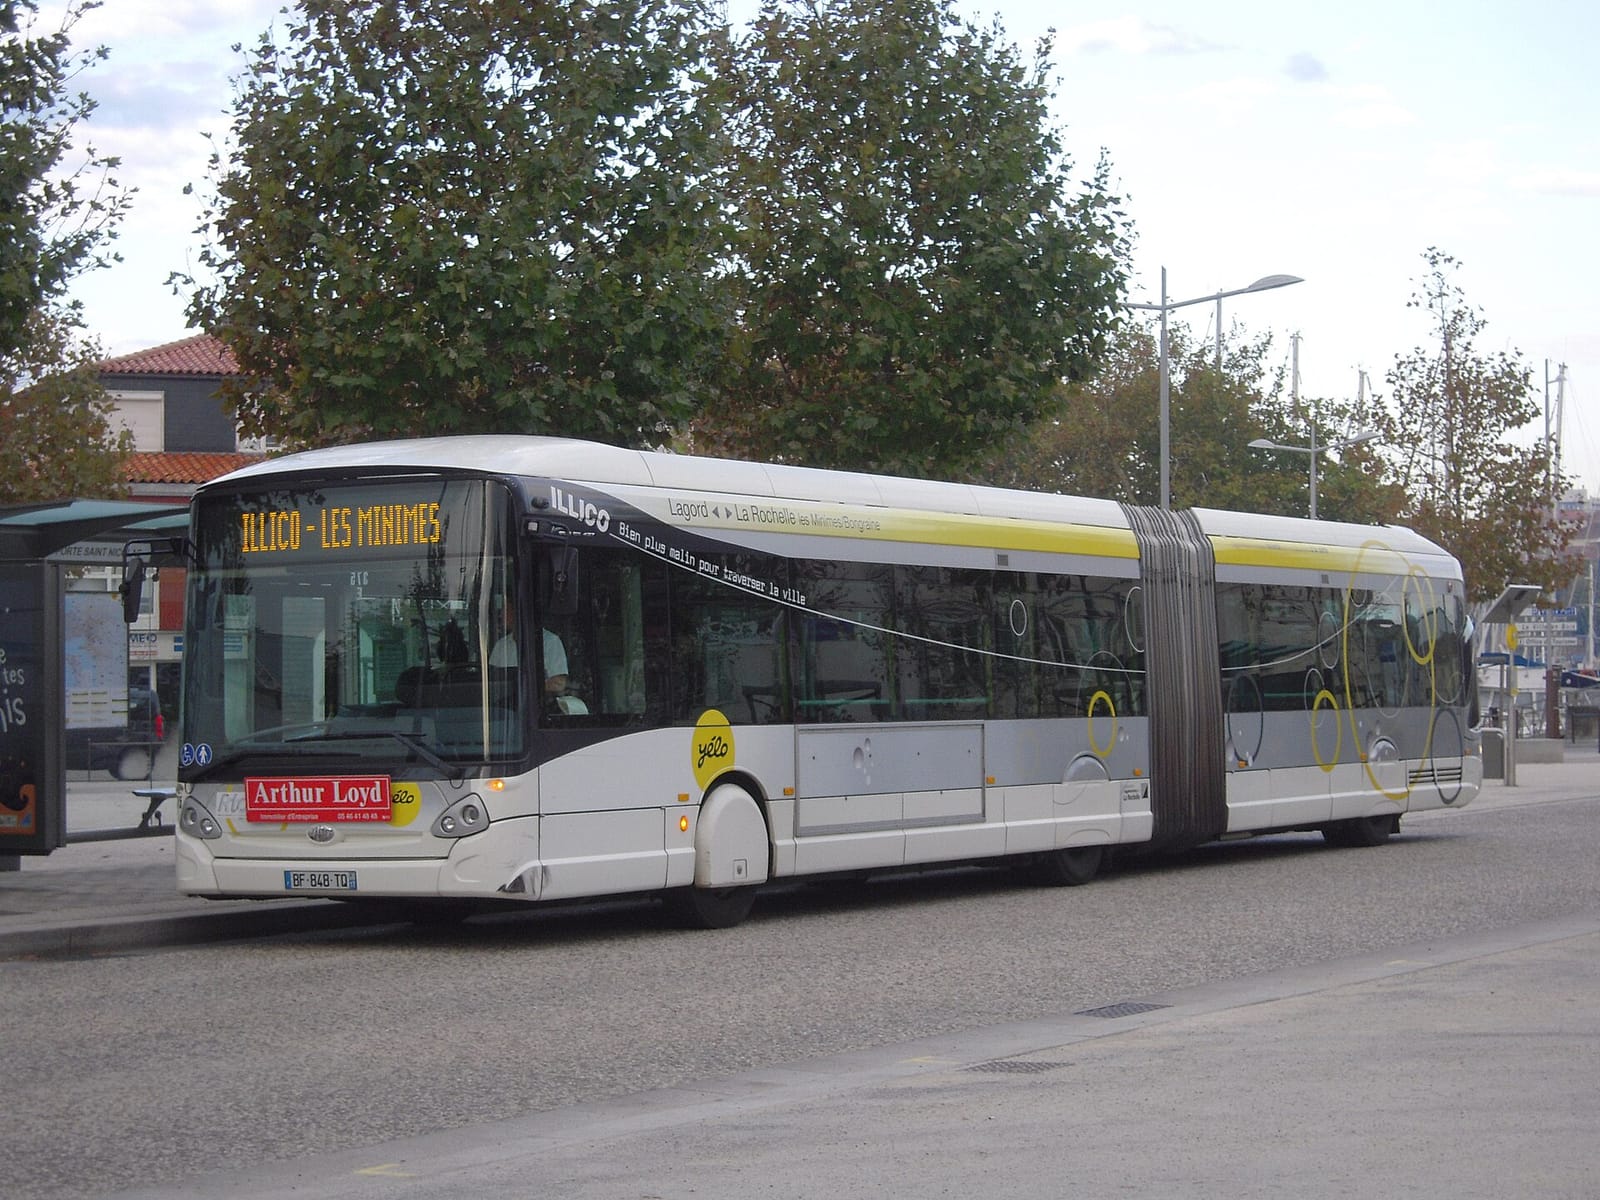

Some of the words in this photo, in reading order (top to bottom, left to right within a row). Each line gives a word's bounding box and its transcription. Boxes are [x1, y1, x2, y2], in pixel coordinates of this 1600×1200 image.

[549, 486, 610, 534] ILLICO
[668, 497, 708, 521] Lagord
[734, 503, 749, 522] La
[751, 504, 796, 525] Rochelle
[242, 510, 301, 552] ILLICO
[321, 508, 352, 548] LES
[358, 503, 440, 546] MINIMES
[618, 521, 641, 545] Bien
[644, 535, 666, 554] plus
[669, 545, 696, 567] malin
[698, 559, 719, 576] pour
[723, 565, 766, 594] traverser
[769, 581, 779, 598] la
[782, 587, 807, 606] ville
[697, 736, 729, 769] yélo
[254, 780, 324, 805] Arthur
[332, 779, 383, 808] Loyd
[392, 789, 415, 804] élo
